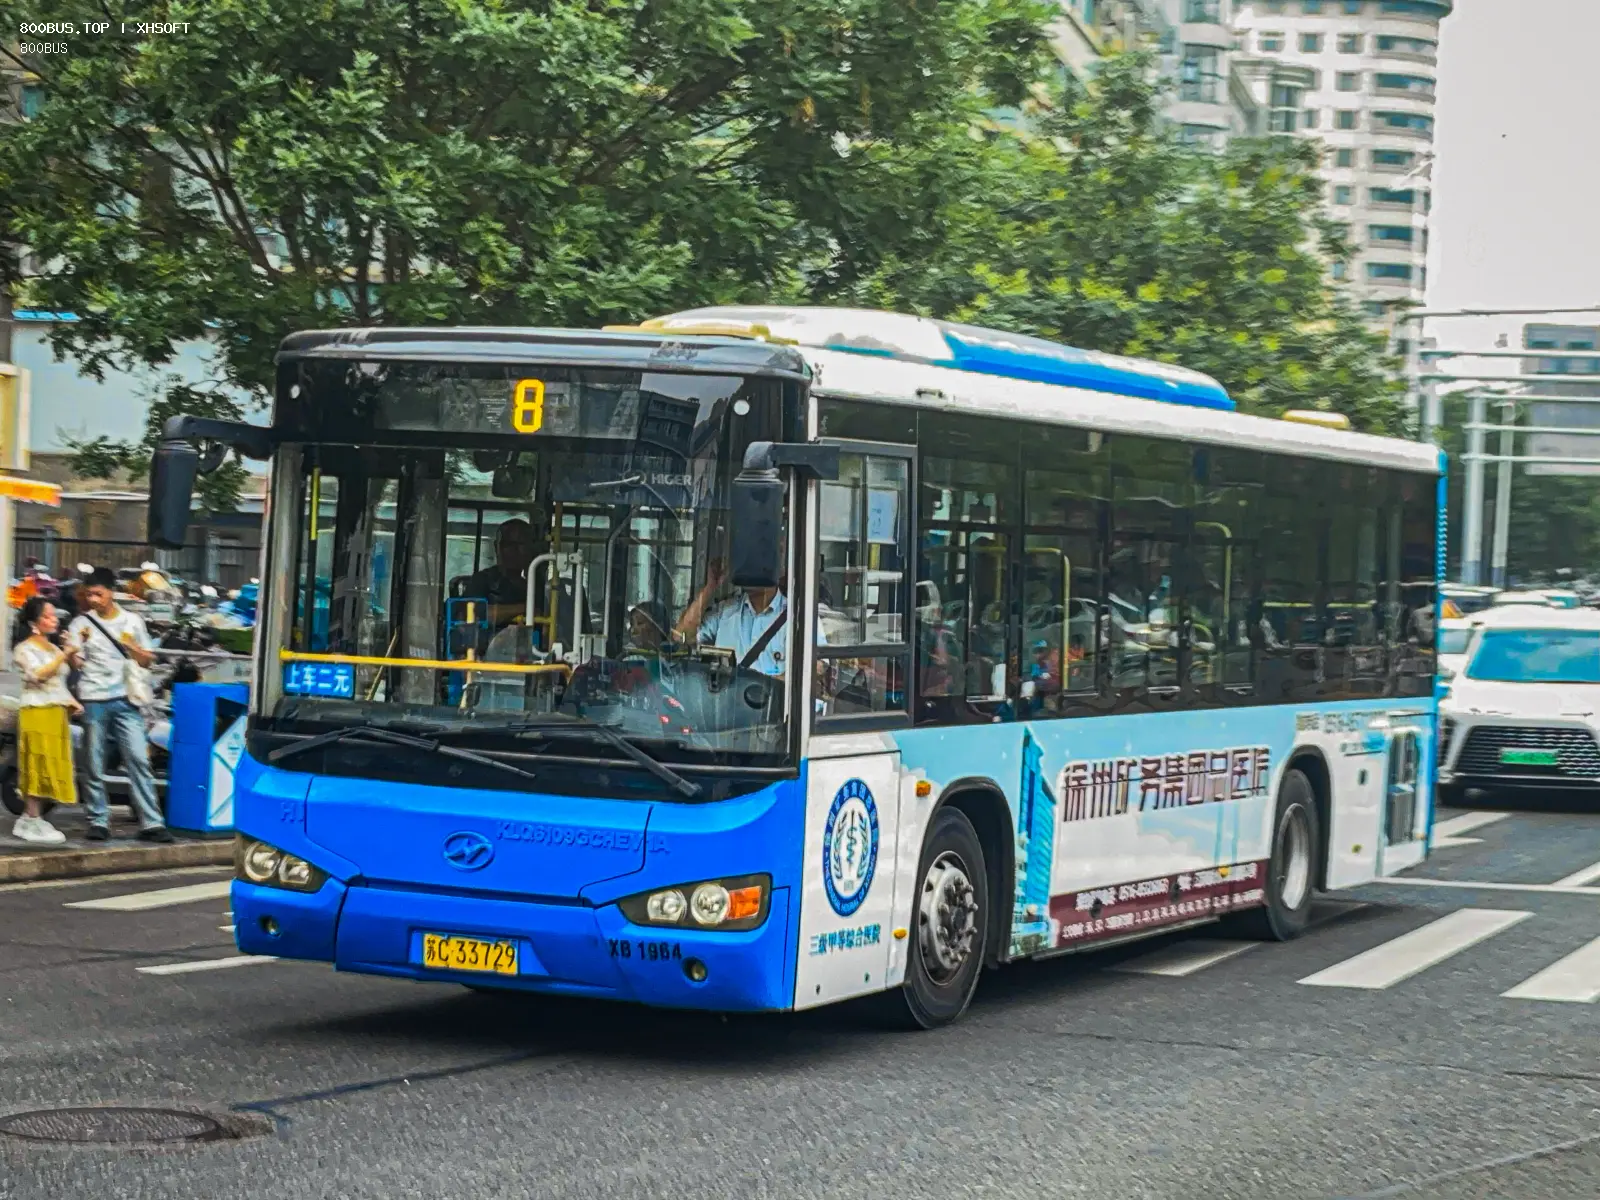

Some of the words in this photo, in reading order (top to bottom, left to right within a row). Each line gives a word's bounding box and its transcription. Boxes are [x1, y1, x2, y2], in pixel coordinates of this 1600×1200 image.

[512, 378, 545, 433] 8
[651, 473, 692, 486] HIGER
[286, 664, 350, 693] 上车二元
